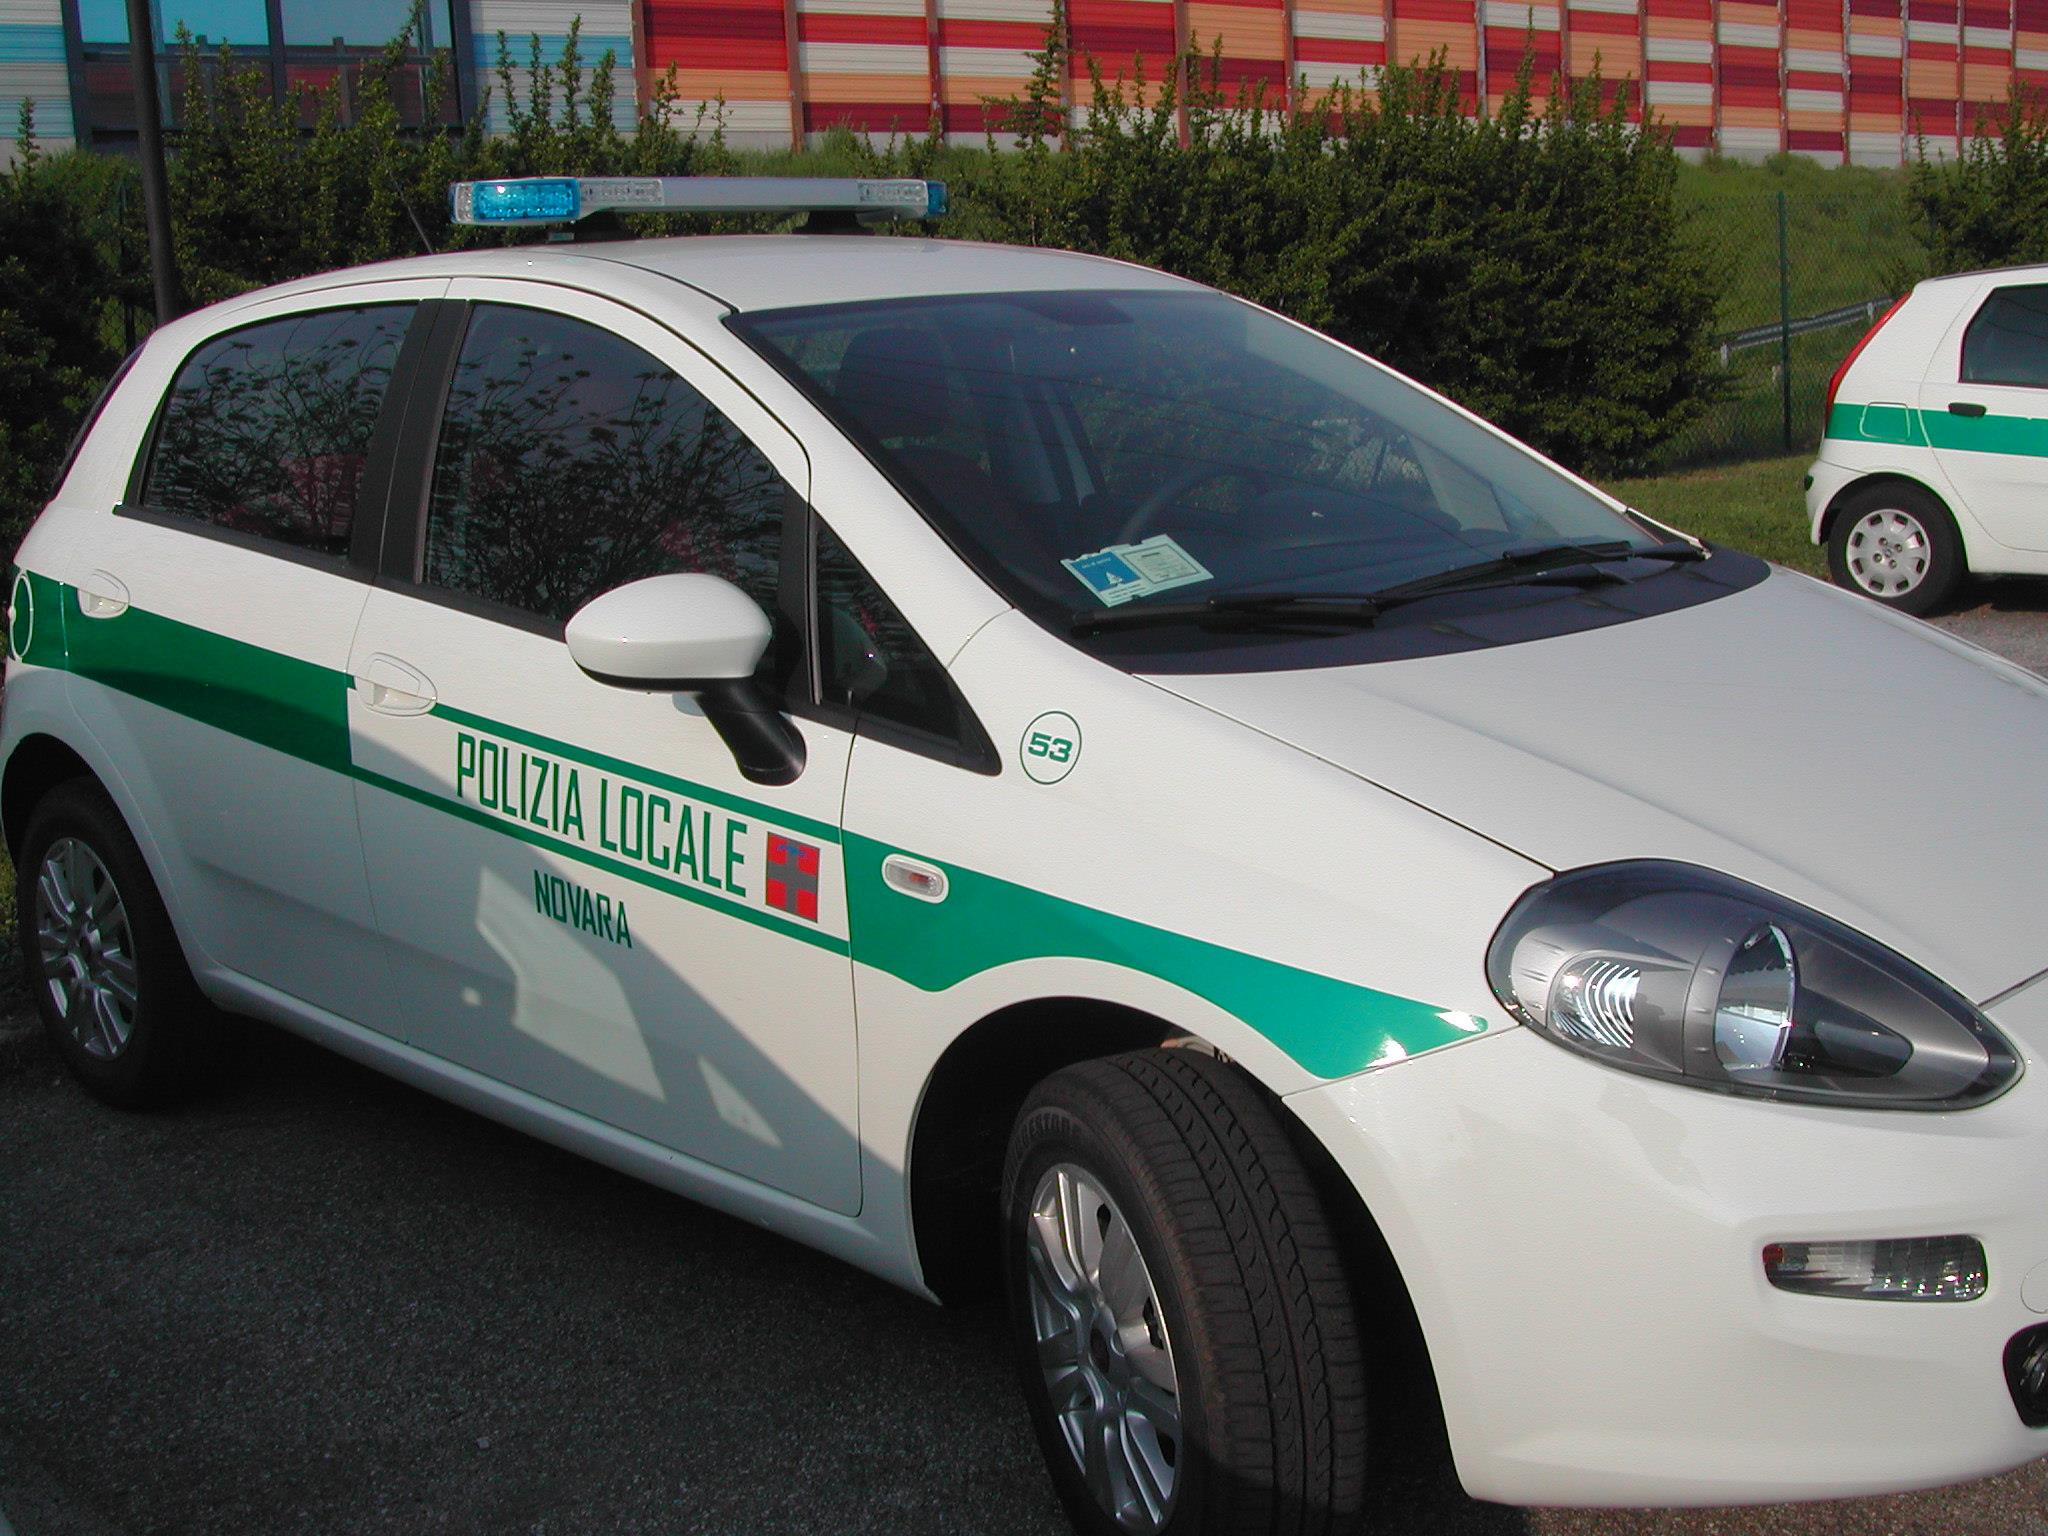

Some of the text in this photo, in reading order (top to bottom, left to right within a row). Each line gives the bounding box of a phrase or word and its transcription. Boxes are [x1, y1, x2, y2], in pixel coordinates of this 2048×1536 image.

[1028, 731, 1073, 763] 53
[457, 732, 748, 898] POLIZIA LOCALE
[534, 870, 632, 948] NOVARA
